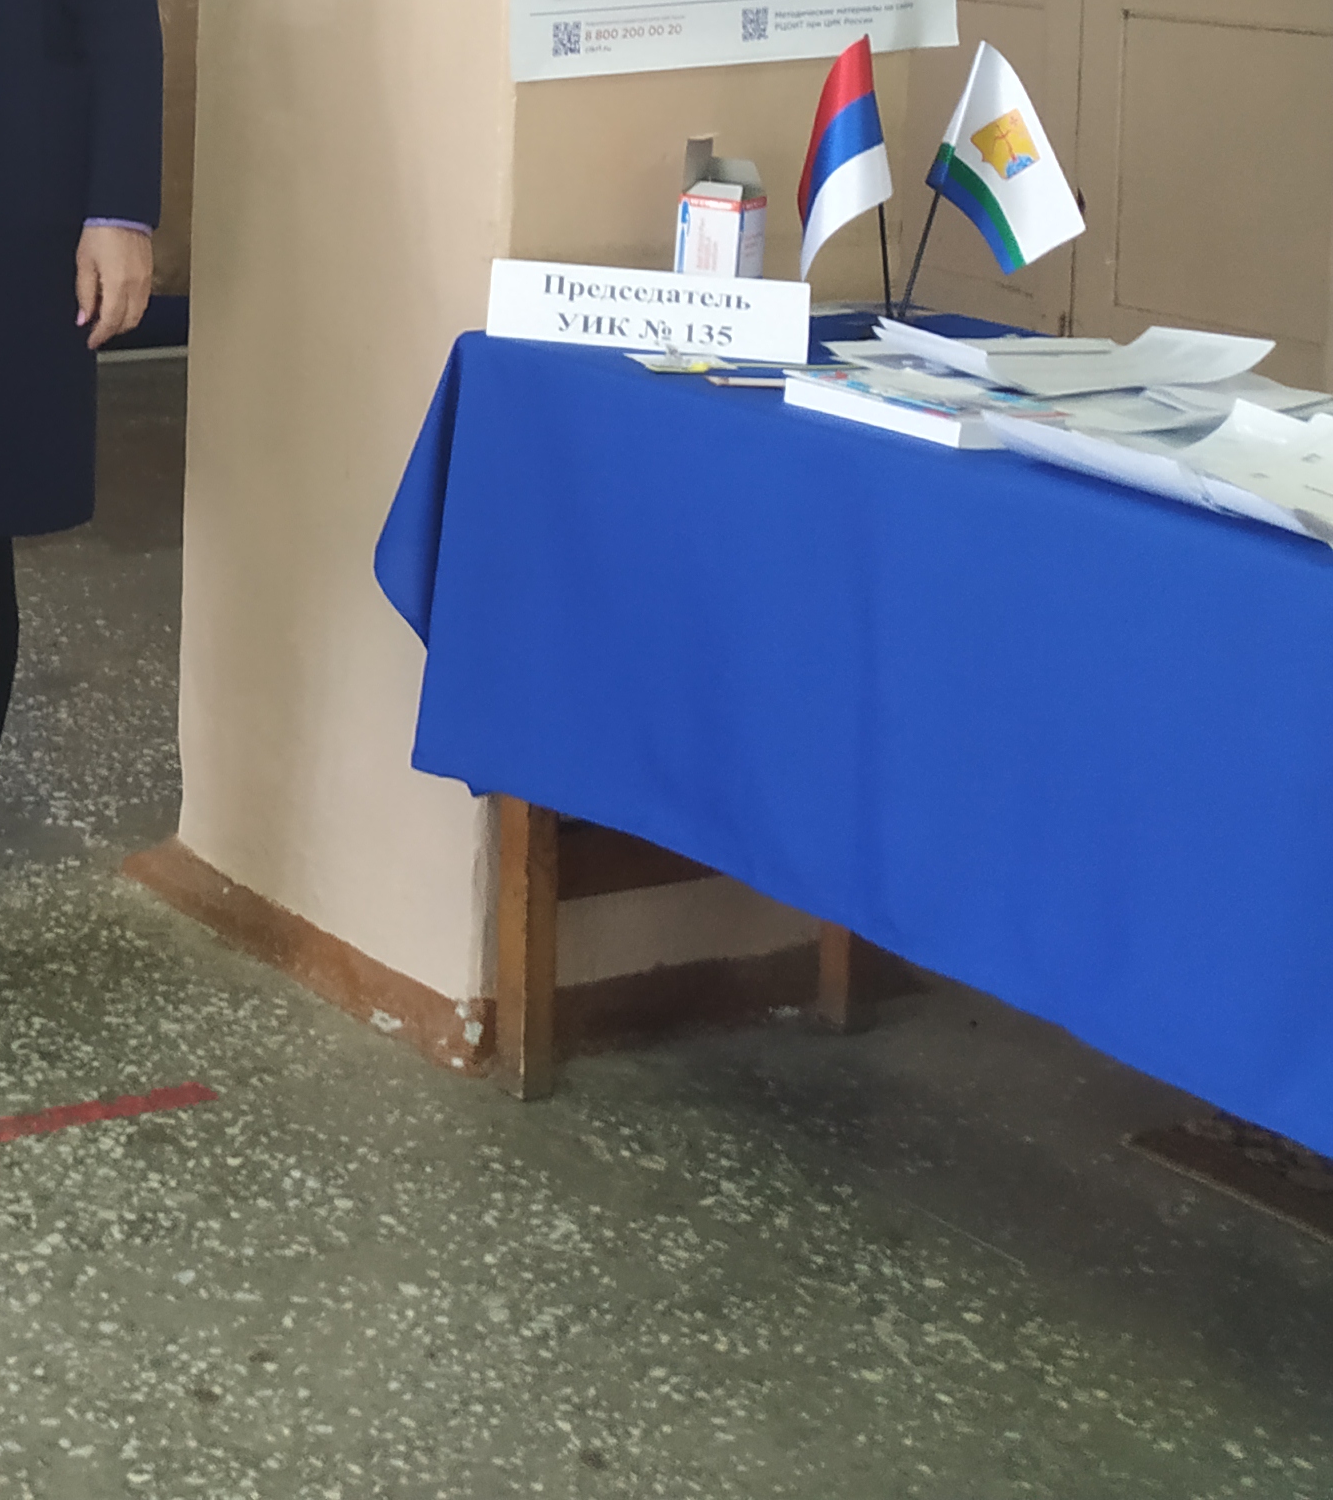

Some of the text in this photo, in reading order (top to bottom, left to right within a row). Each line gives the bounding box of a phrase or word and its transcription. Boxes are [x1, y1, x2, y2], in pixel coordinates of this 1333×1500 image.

[585, 23, 683, 41] 8 800 200 00 20
[543, 273, 752, 312] Председатель
[557, 311, 734, 347] УИК № 135
